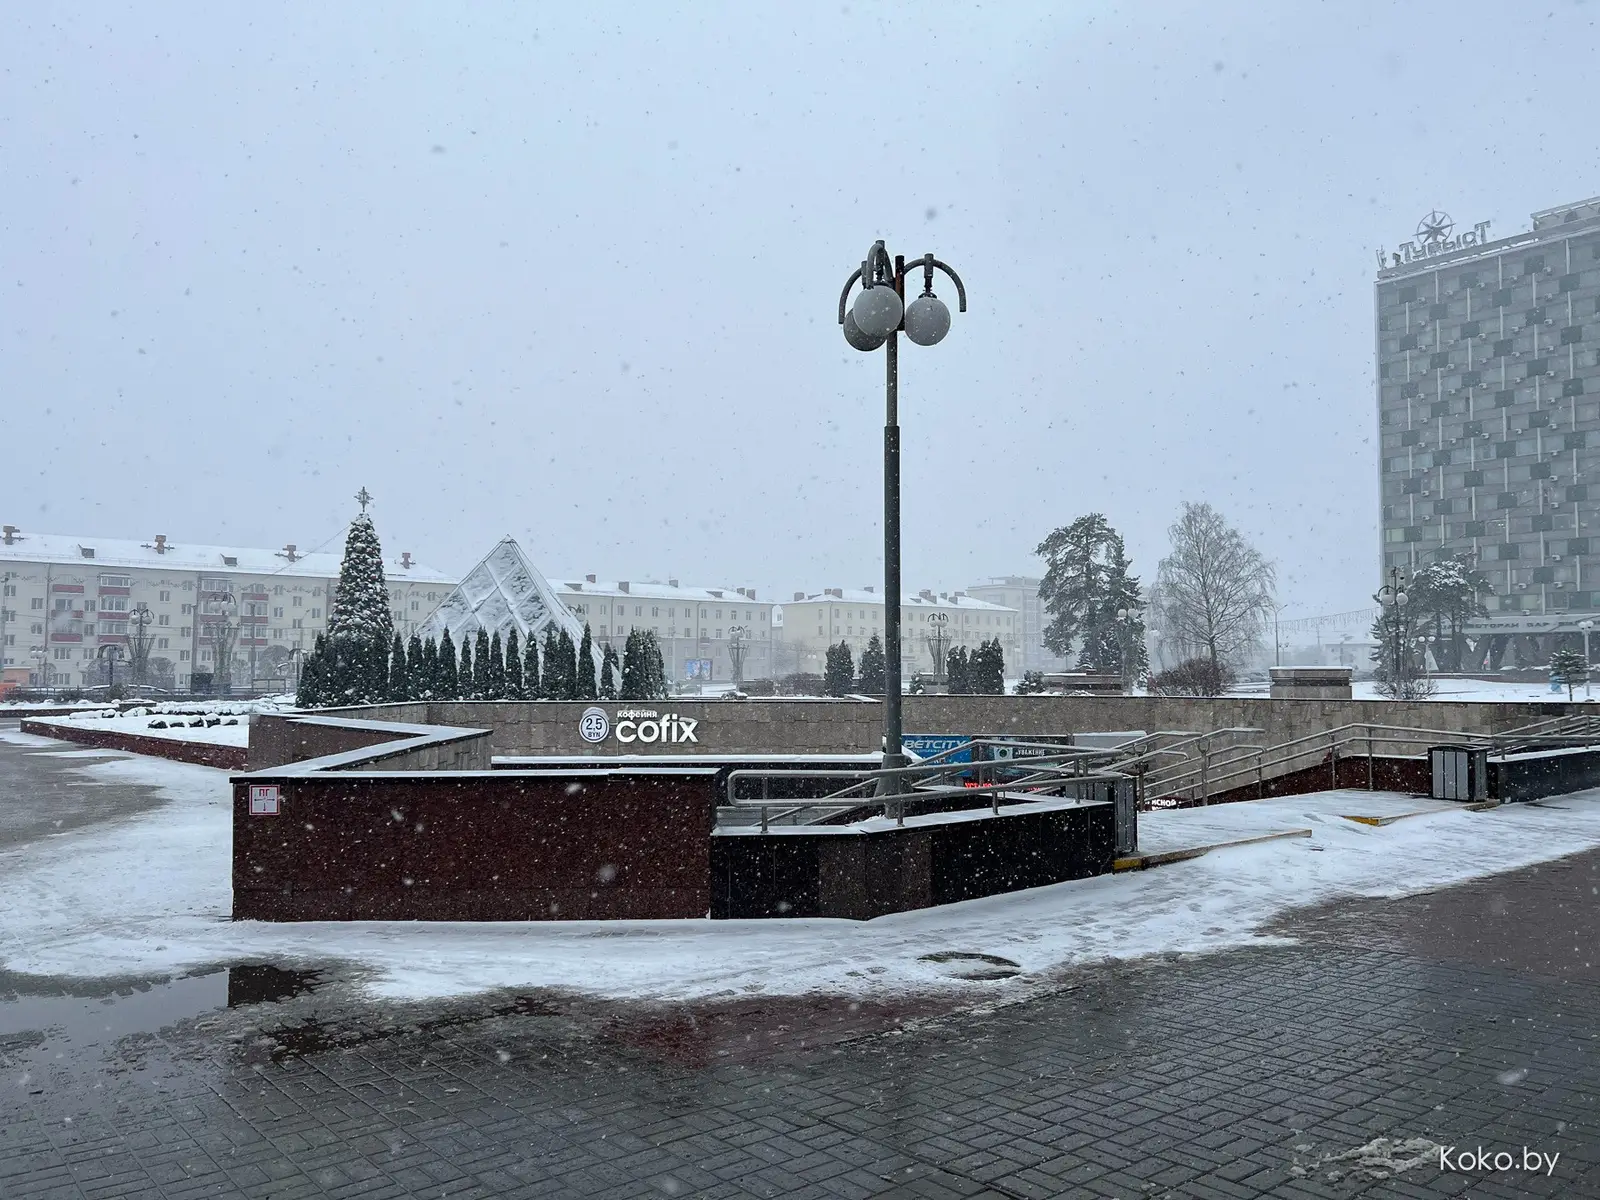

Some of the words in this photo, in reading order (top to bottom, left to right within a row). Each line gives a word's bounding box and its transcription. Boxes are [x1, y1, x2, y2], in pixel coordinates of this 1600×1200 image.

[615, 713, 699, 743] cofix
[903, 739, 967, 749] BETCITY
[258, 788, 271, 797] ПГ
